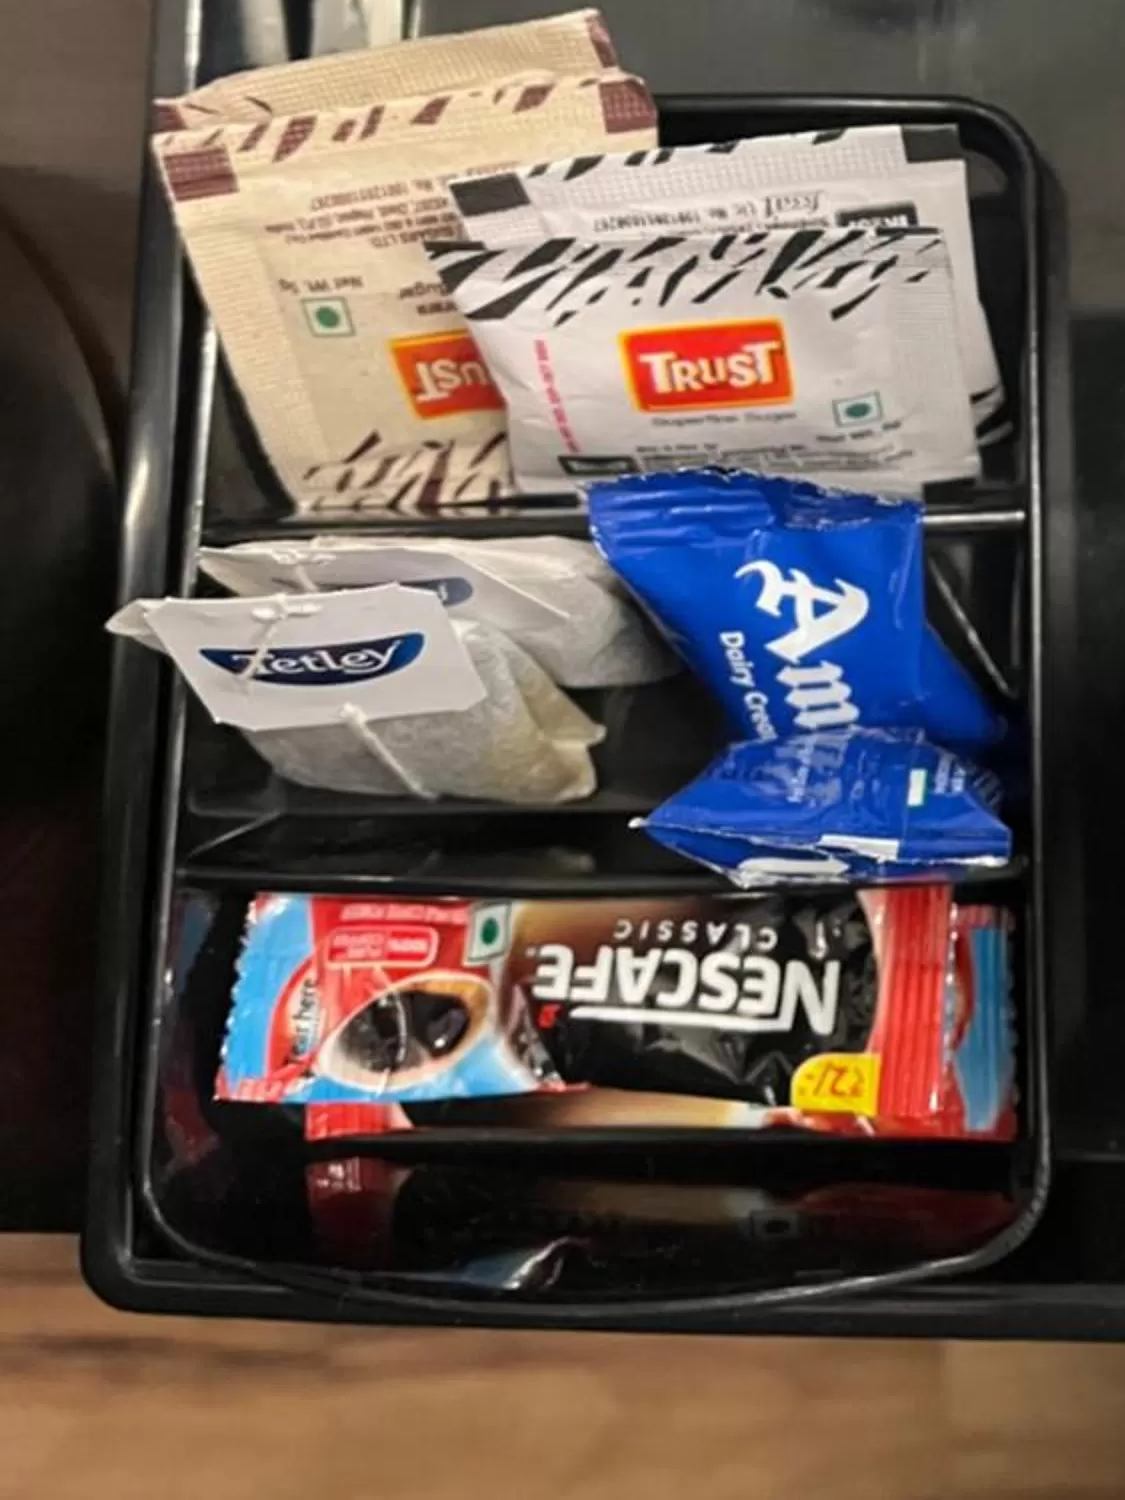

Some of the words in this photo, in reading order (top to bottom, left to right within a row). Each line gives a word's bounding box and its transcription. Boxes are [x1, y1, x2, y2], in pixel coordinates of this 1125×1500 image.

[414, 357, 490, 402] UST
[638, 340, 781, 394] TRUST
[232, 639, 403, 676] Tetley
[719, 631, 756, 687] Dairy
[612, 919, 778, 950] CLASSIC
